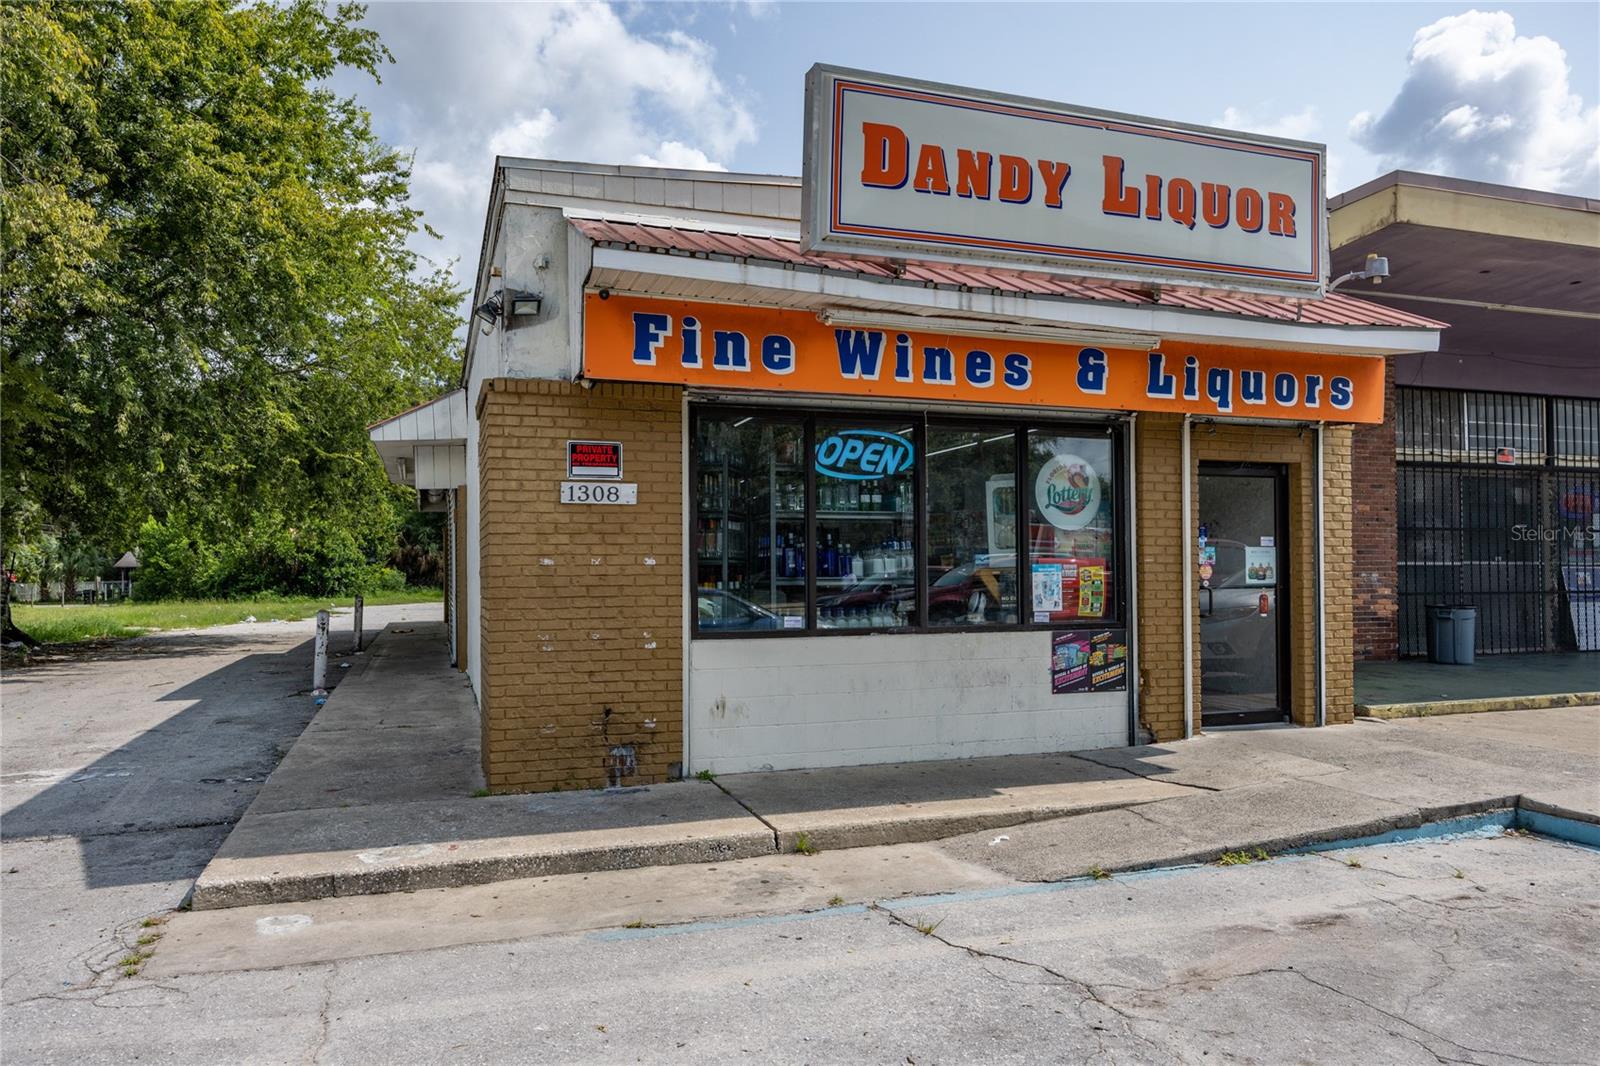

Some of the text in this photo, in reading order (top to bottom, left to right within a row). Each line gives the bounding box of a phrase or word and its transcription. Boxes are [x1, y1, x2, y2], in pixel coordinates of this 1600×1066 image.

[860, 121, 1297, 238] DANDY LIQUOR
[632, 311, 1355, 413] Fine Wines & Liquors
[571, 453, 618, 463] PROPERTY
[576, 445, 613, 454] PRIVATE
[817, 436, 905, 475] OPEN
[567, 485, 620, 503] 1308
[1045, 484, 1094, 511] Lottery
